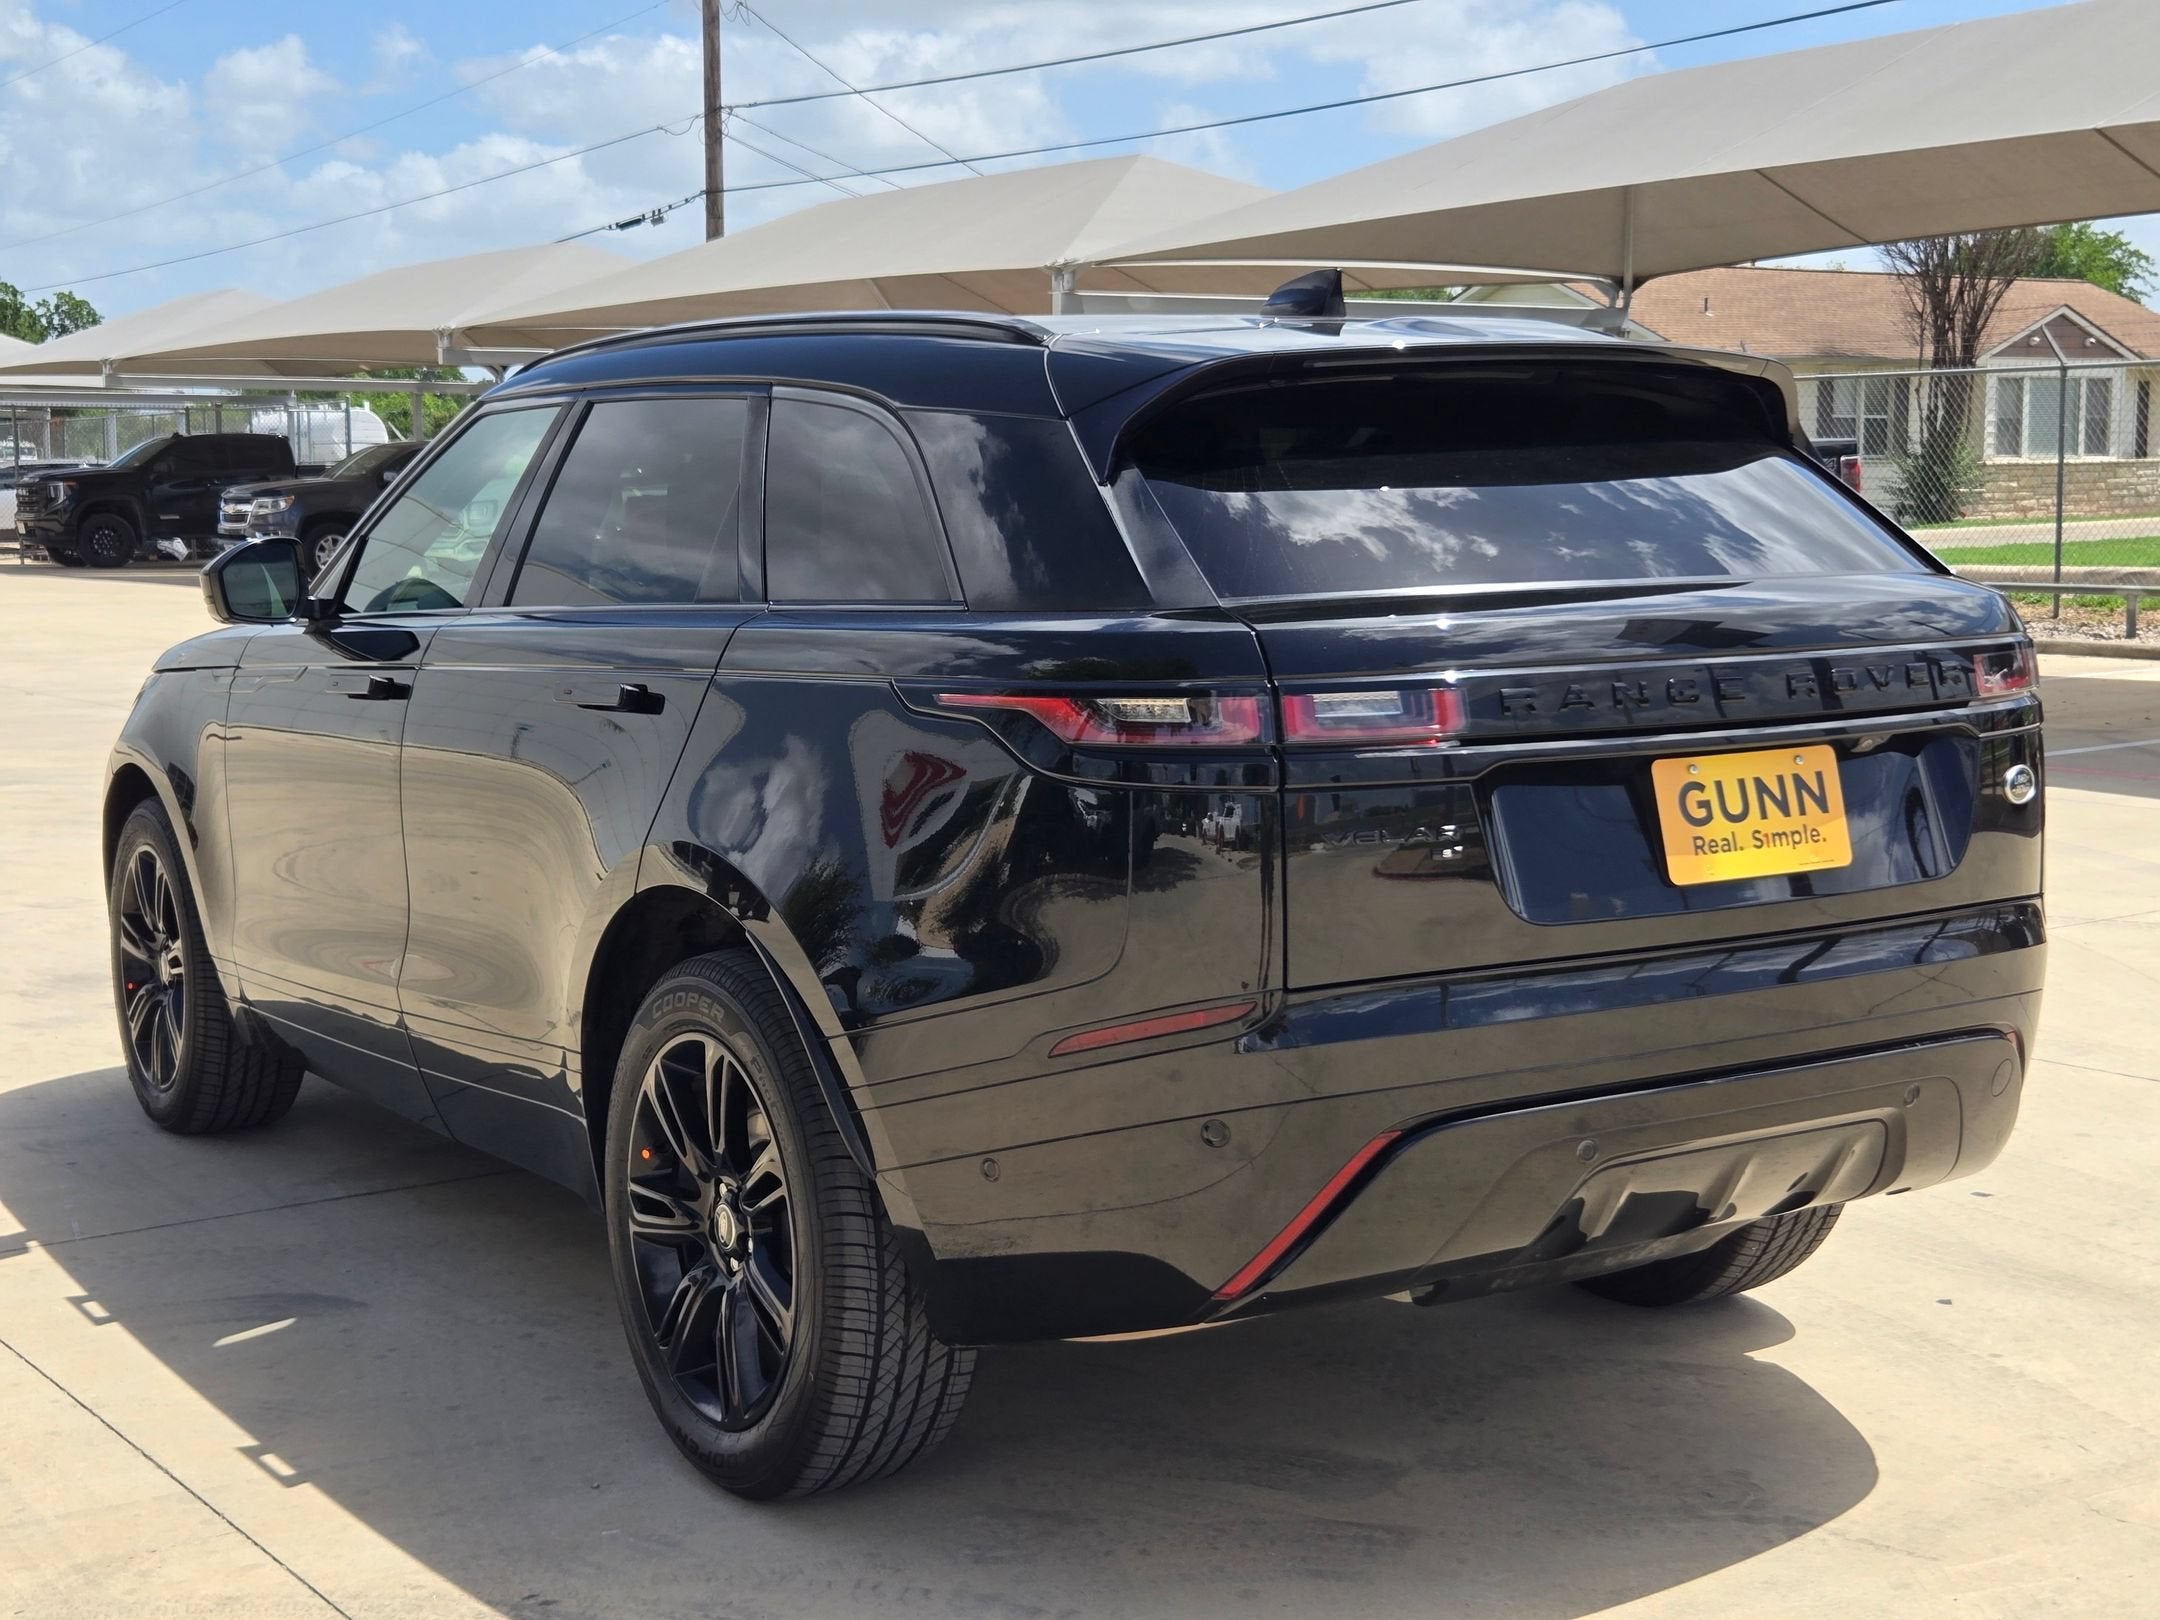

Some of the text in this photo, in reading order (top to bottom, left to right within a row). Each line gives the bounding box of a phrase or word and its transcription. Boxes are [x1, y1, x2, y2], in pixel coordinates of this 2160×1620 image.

[1499, 660, 1966, 716] RANGE ROVER
[1678, 770, 1830, 828] GUNN
[1321, 824, 1465, 847] VELAR
[1692, 831, 1744, 856] Real.
[651, 991, 726, 1023] COOPER
